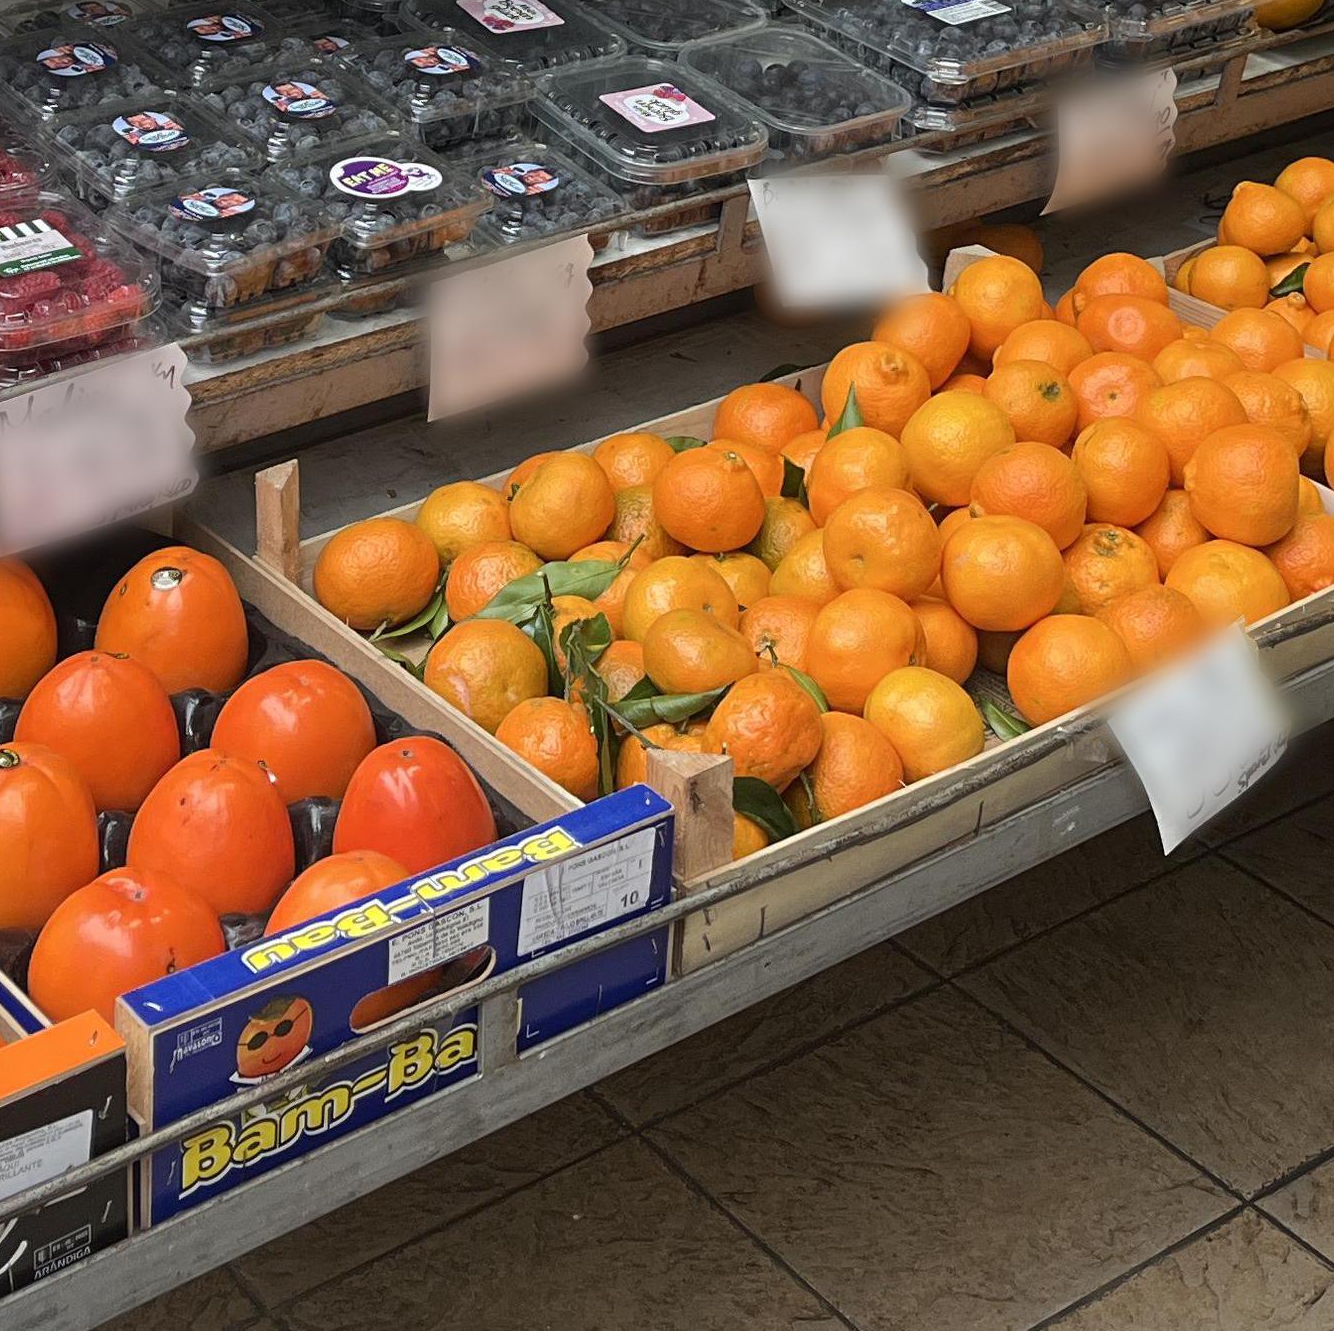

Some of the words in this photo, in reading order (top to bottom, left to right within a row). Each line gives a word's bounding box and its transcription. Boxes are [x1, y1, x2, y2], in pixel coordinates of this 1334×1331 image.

[341, 172, 368, 188] EAT
[372, 162, 397, 178] ME
[620, 888, 640, 909] 10
[179, 1023, 479, 1200] Bam-Ba
